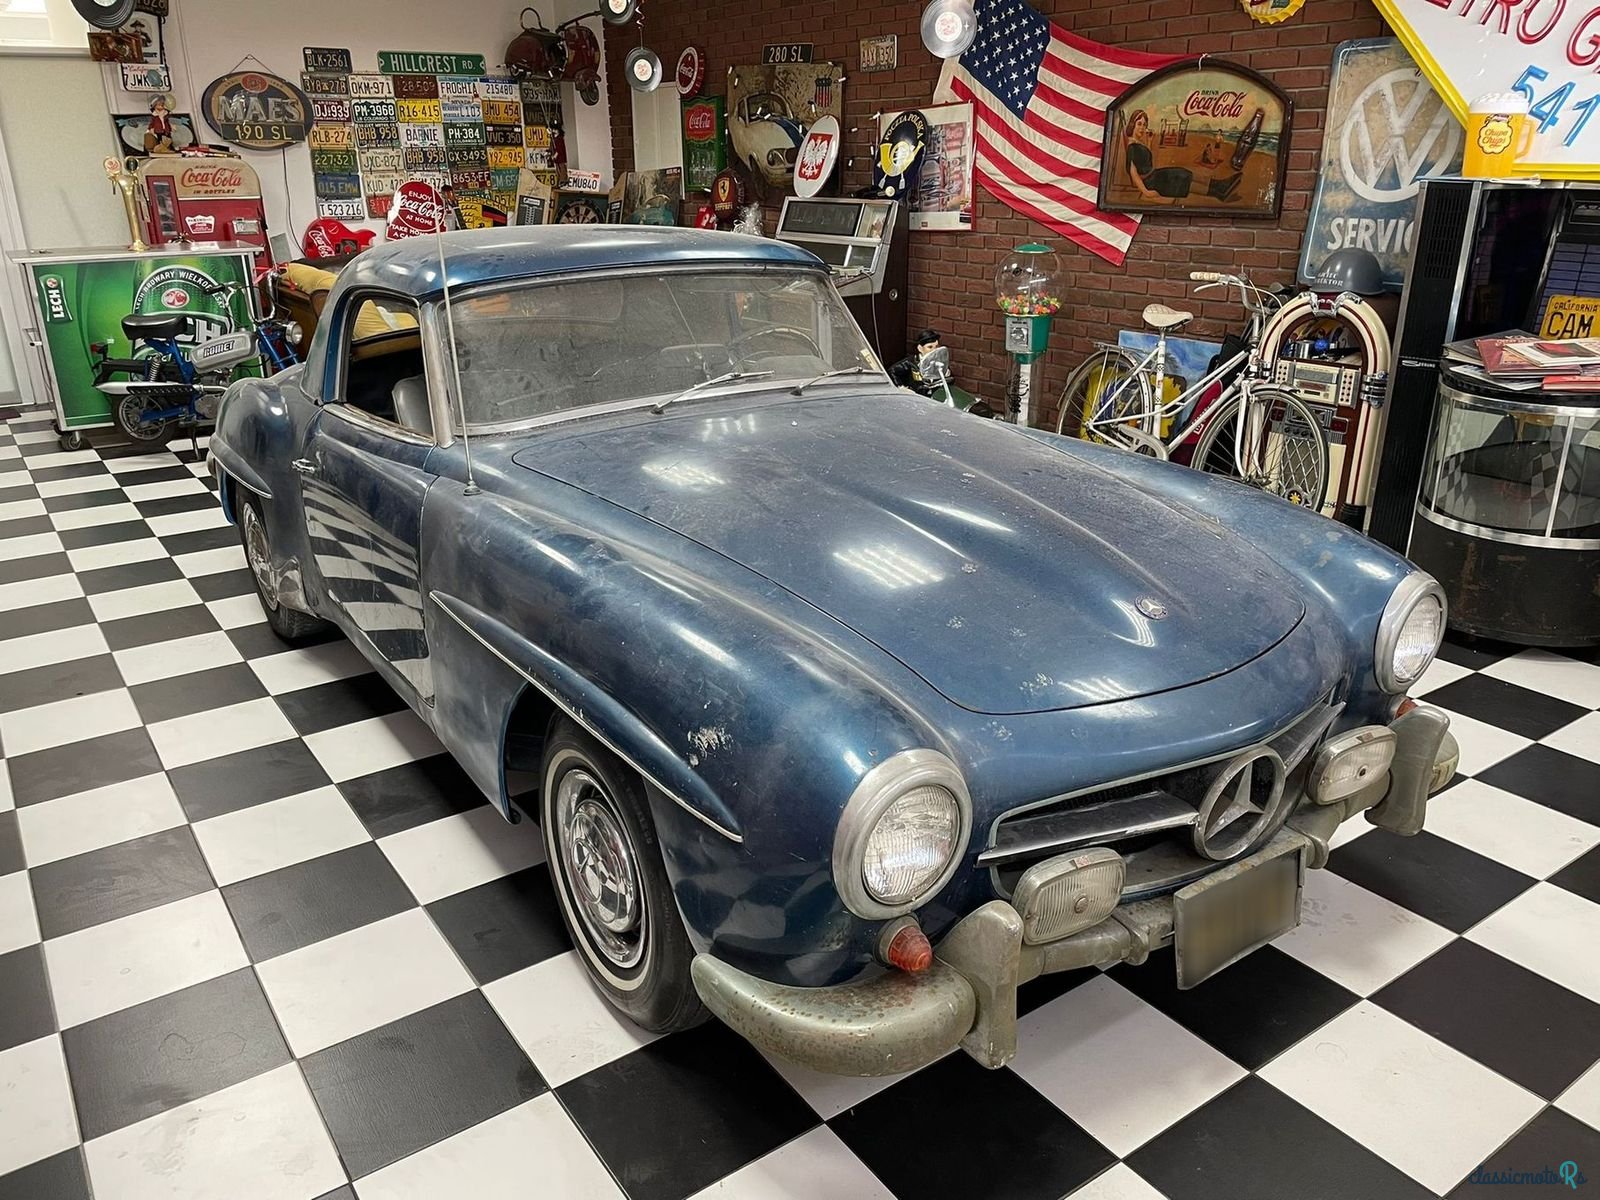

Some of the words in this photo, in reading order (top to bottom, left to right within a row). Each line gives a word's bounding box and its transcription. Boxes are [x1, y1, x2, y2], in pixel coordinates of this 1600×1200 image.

[768, 47, 787, 63] 280
[790, 45, 804, 62] SL
[390, 54, 457, 73] HILLCREST
[485, 83, 514, 95] 215480
[217, 95, 300, 122] MAES
[1184, 90, 1247, 118] Coca-Cola
[503, 104, 519, 117] 454
[235, 125, 265, 140] 190
[270, 125, 293, 140] SL
[379, 127, 398, 139] 958
[506, 132, 521, 143] 350
[1482, 136, 1507, 145] Chups
[426, 151, 445, 163] 958
[508, 152, 523, 164] 945
[181, 167, 242, 188] Coca-Cola
[408, 190, 434, 202] ENJOY
[319, 203, 326, 216] T
[327, 204, 344, 216] 523
[345, 204, 362, 216] 216
[414, 216, 434, 227] HOME
[391, 223, 408, 233] TAKE
[47, 289, 65, 319] LECH
[1553, 301, 1599, 312] CALIFORNIA
[1547, 311, 1595, 339] CAM
